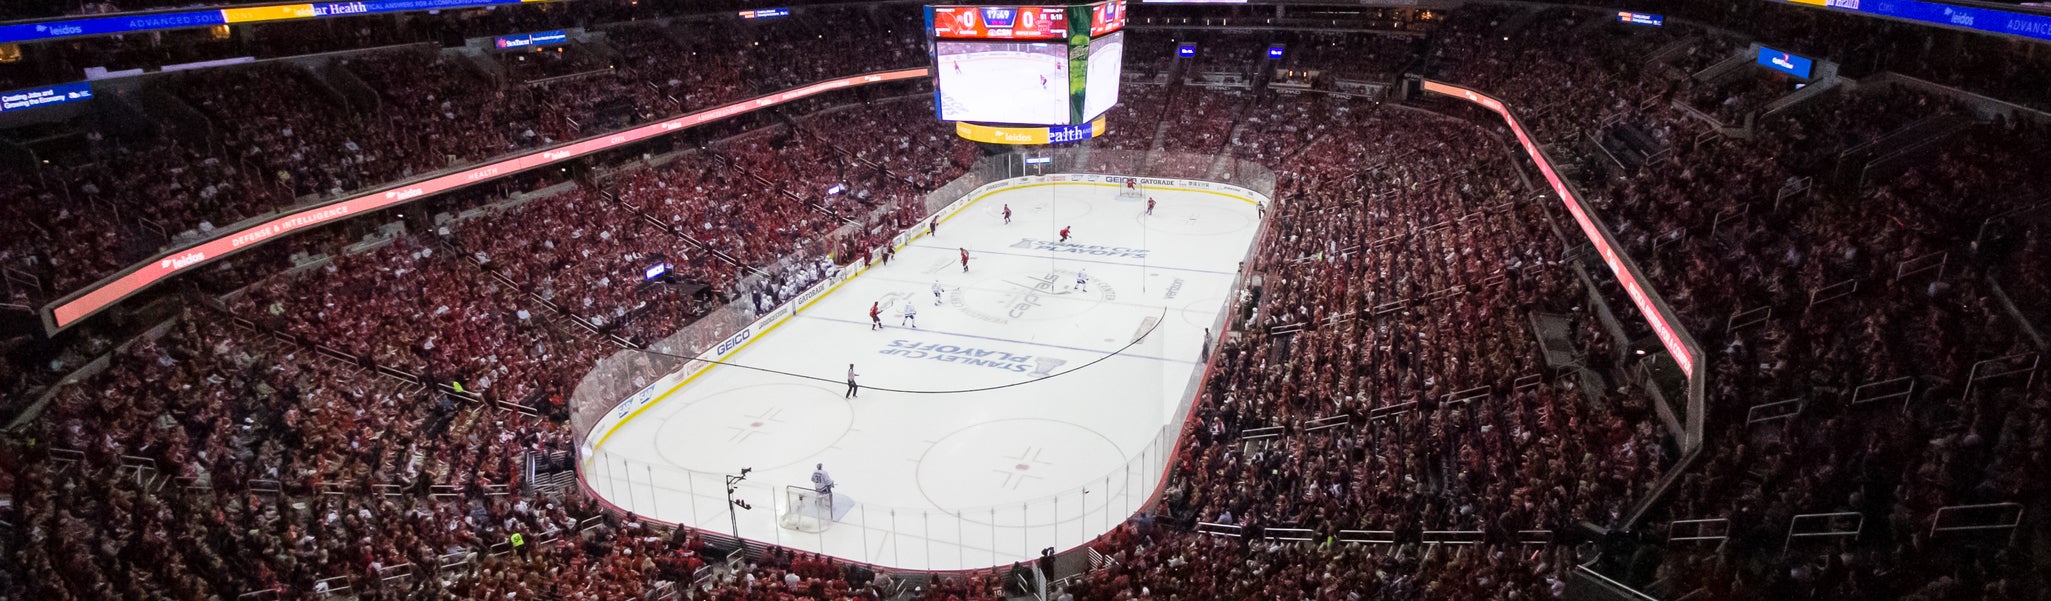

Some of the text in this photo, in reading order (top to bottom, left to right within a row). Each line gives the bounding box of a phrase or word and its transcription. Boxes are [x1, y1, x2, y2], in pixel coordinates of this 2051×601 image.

[328, 1, 368, 15] Health
[129, 14, 191, 28] ADVANCED
[963, 11, 974, 27] 0
[1022, 11, 1034, 28] 0
[1951, 10, 1974, 26] leidos
[50, 25, 82, 36] leidos
[1005, 131, 1033, 142] leidos
[467, 168, 499, 180] HEALTH
[1140, 178, 1174, 186] GATORADE
[231, 227, 272, 247] DEFENSE
[281, 205, 349, 229] INTELLIGENCE
[172, 251, 205, 270] leidos
[798, 283, 825, 305] GATORADE
[717, 328, 751, 356] GEICO
[887, 339, 1032, 363] PLAYOFFS
[879, 349, 1033, 373] STANLEY CUP
